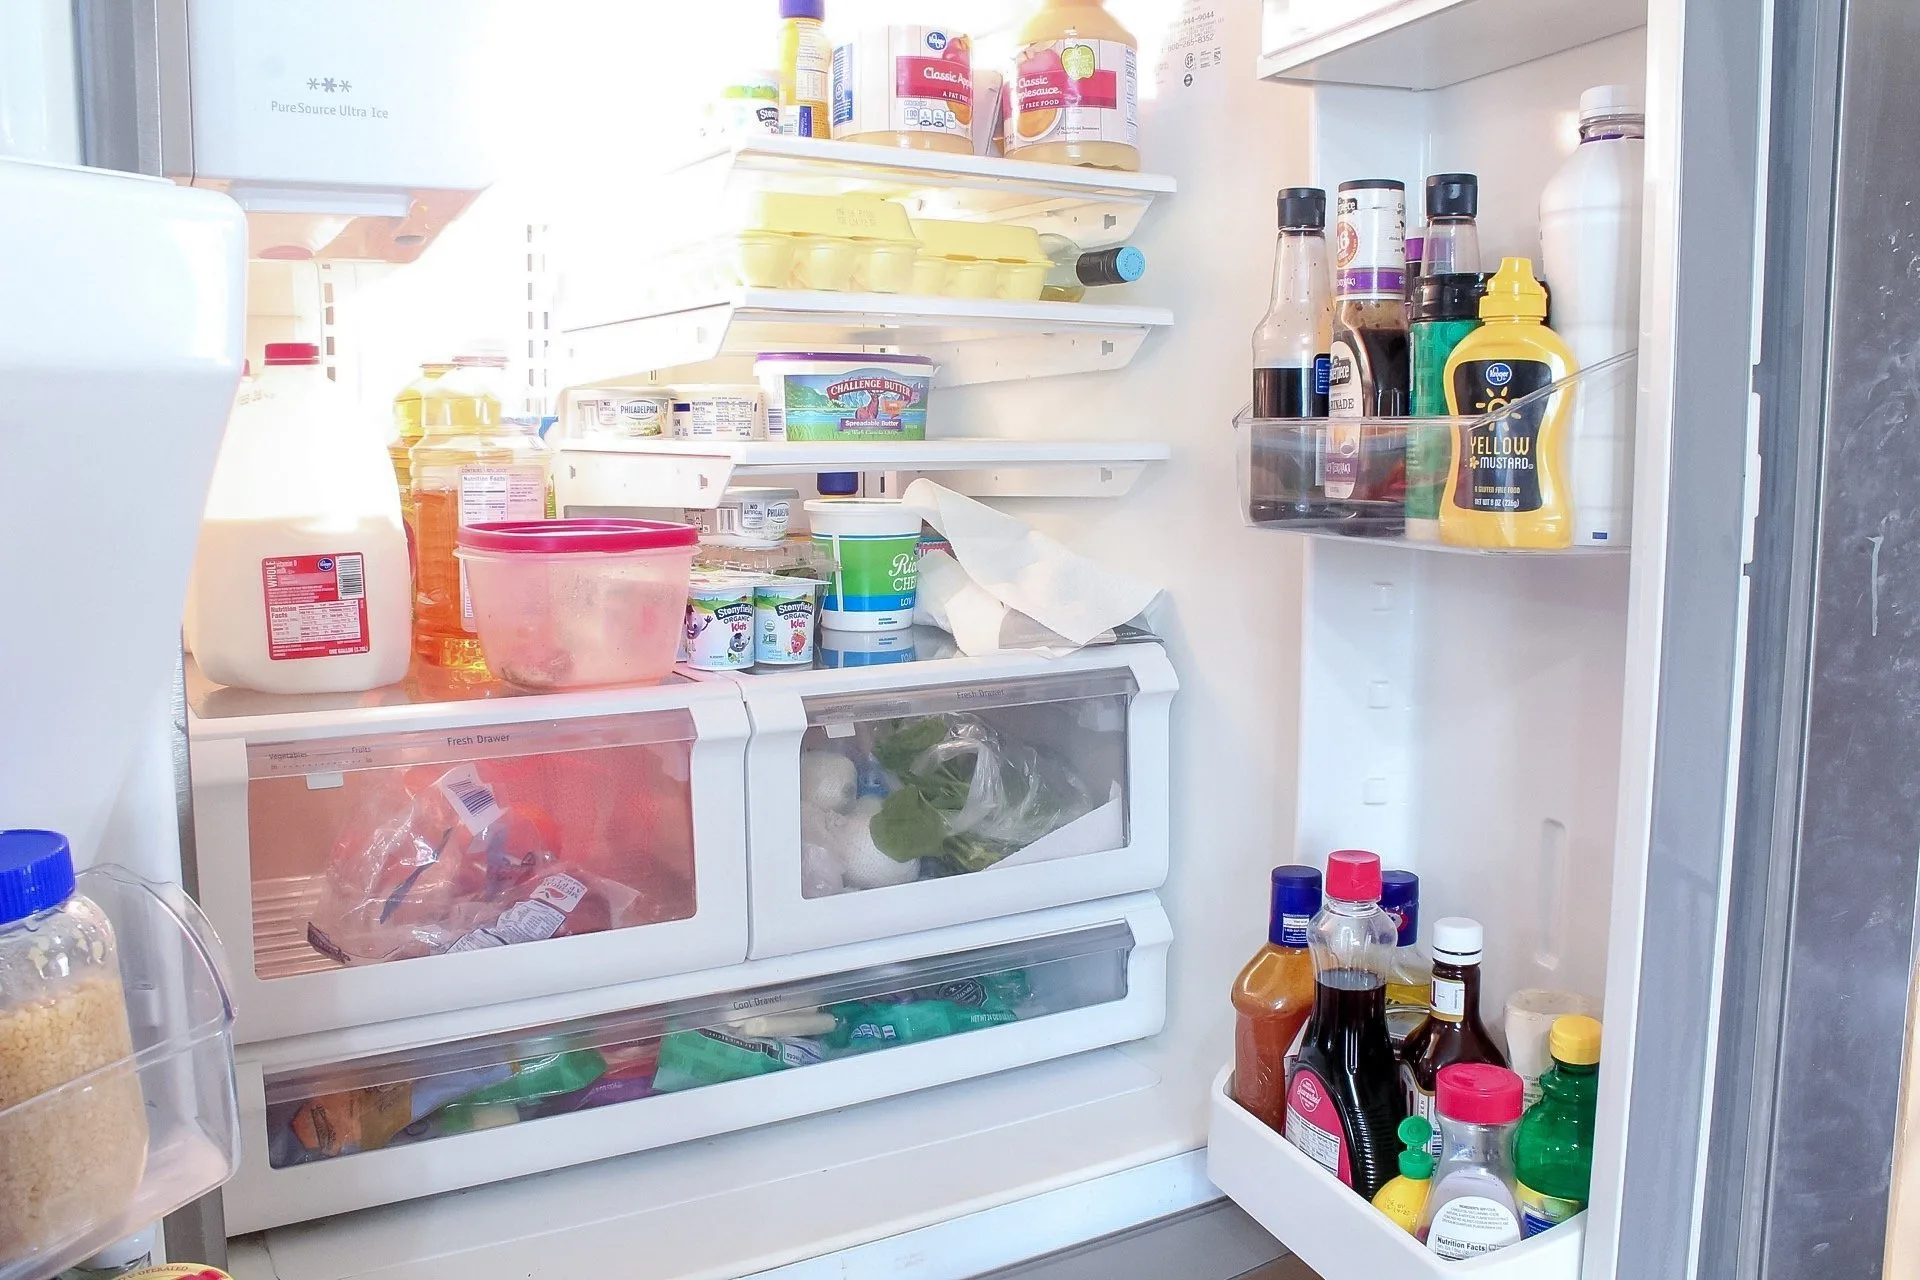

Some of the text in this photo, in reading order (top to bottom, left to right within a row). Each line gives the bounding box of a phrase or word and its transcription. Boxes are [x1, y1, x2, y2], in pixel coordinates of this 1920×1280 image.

[924, 67, 957, 82] Classic
[1018, 75, 1048, 88] Classic
[949, 91, 958, 99] FAT
[271, 100, 389, 119] PureSource Ultra Ice
[1489, 366, 1510, 382] Kroger
[830, 379, 911, 396] CHALLENGE BUTTER
[620, 404, 657, 415] PHILADELPHIA
[845, 419, 899, 428] Spreadable Butter
[1470, 436, 1530, 456] YELLOW
[1480, 456, 1529, 470] MUSTARD
[265, 560, 279, 588] WHOLE
[717, 603, 753, 618] Stonyfield
[778, 602, 813, 614] Stonyfield
[723, 615, 750, 624] ORGANIC
[956, 688, 1005, 699] Fresh Drawer
[447, 734, 511, 746] Fresh Drawer
[733, 994, 783, 1011] Cool Drawer
[1437, 1236, 1465, 1249] Nutrition
[1466, 1242, 1486, 1252] Facts
[138, 1266, 189, 1276] OPERATED
